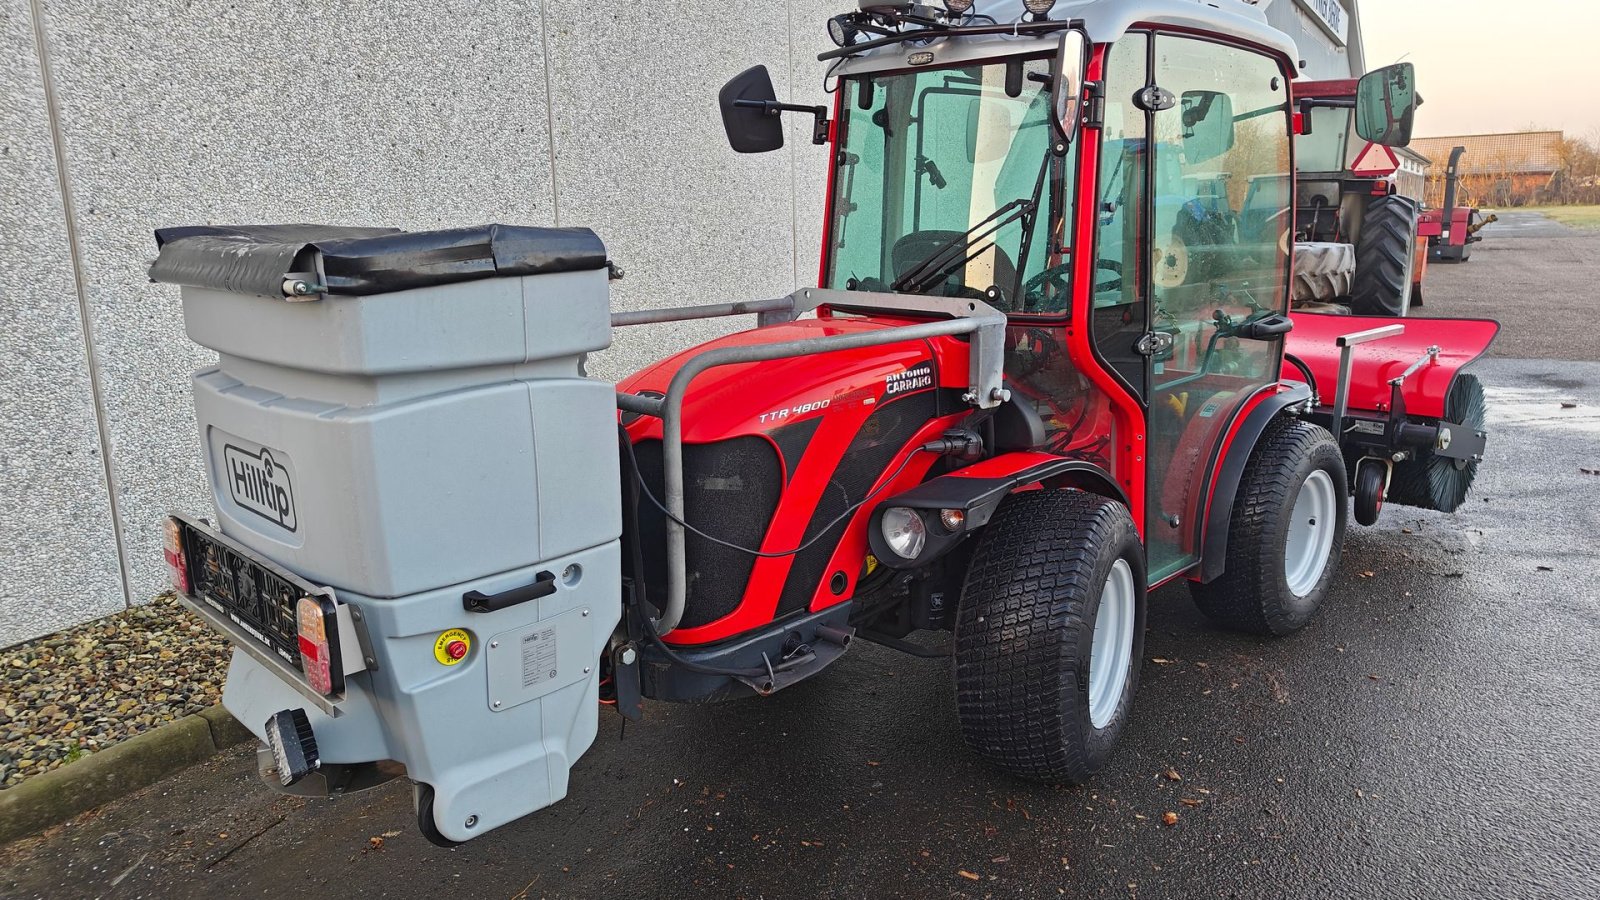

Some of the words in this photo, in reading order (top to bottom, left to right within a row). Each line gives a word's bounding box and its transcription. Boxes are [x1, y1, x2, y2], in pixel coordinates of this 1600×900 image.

[886, 367, 931, 382] ANTONIO
[886, 376, 931, 394] CARRARO
[759, 409, 789, 424] TTR
[792, 399, 831, 415] 4800
[230, 456, 290, 524] Hilltip
[437, 631, 467, 650] EMERGENCY
